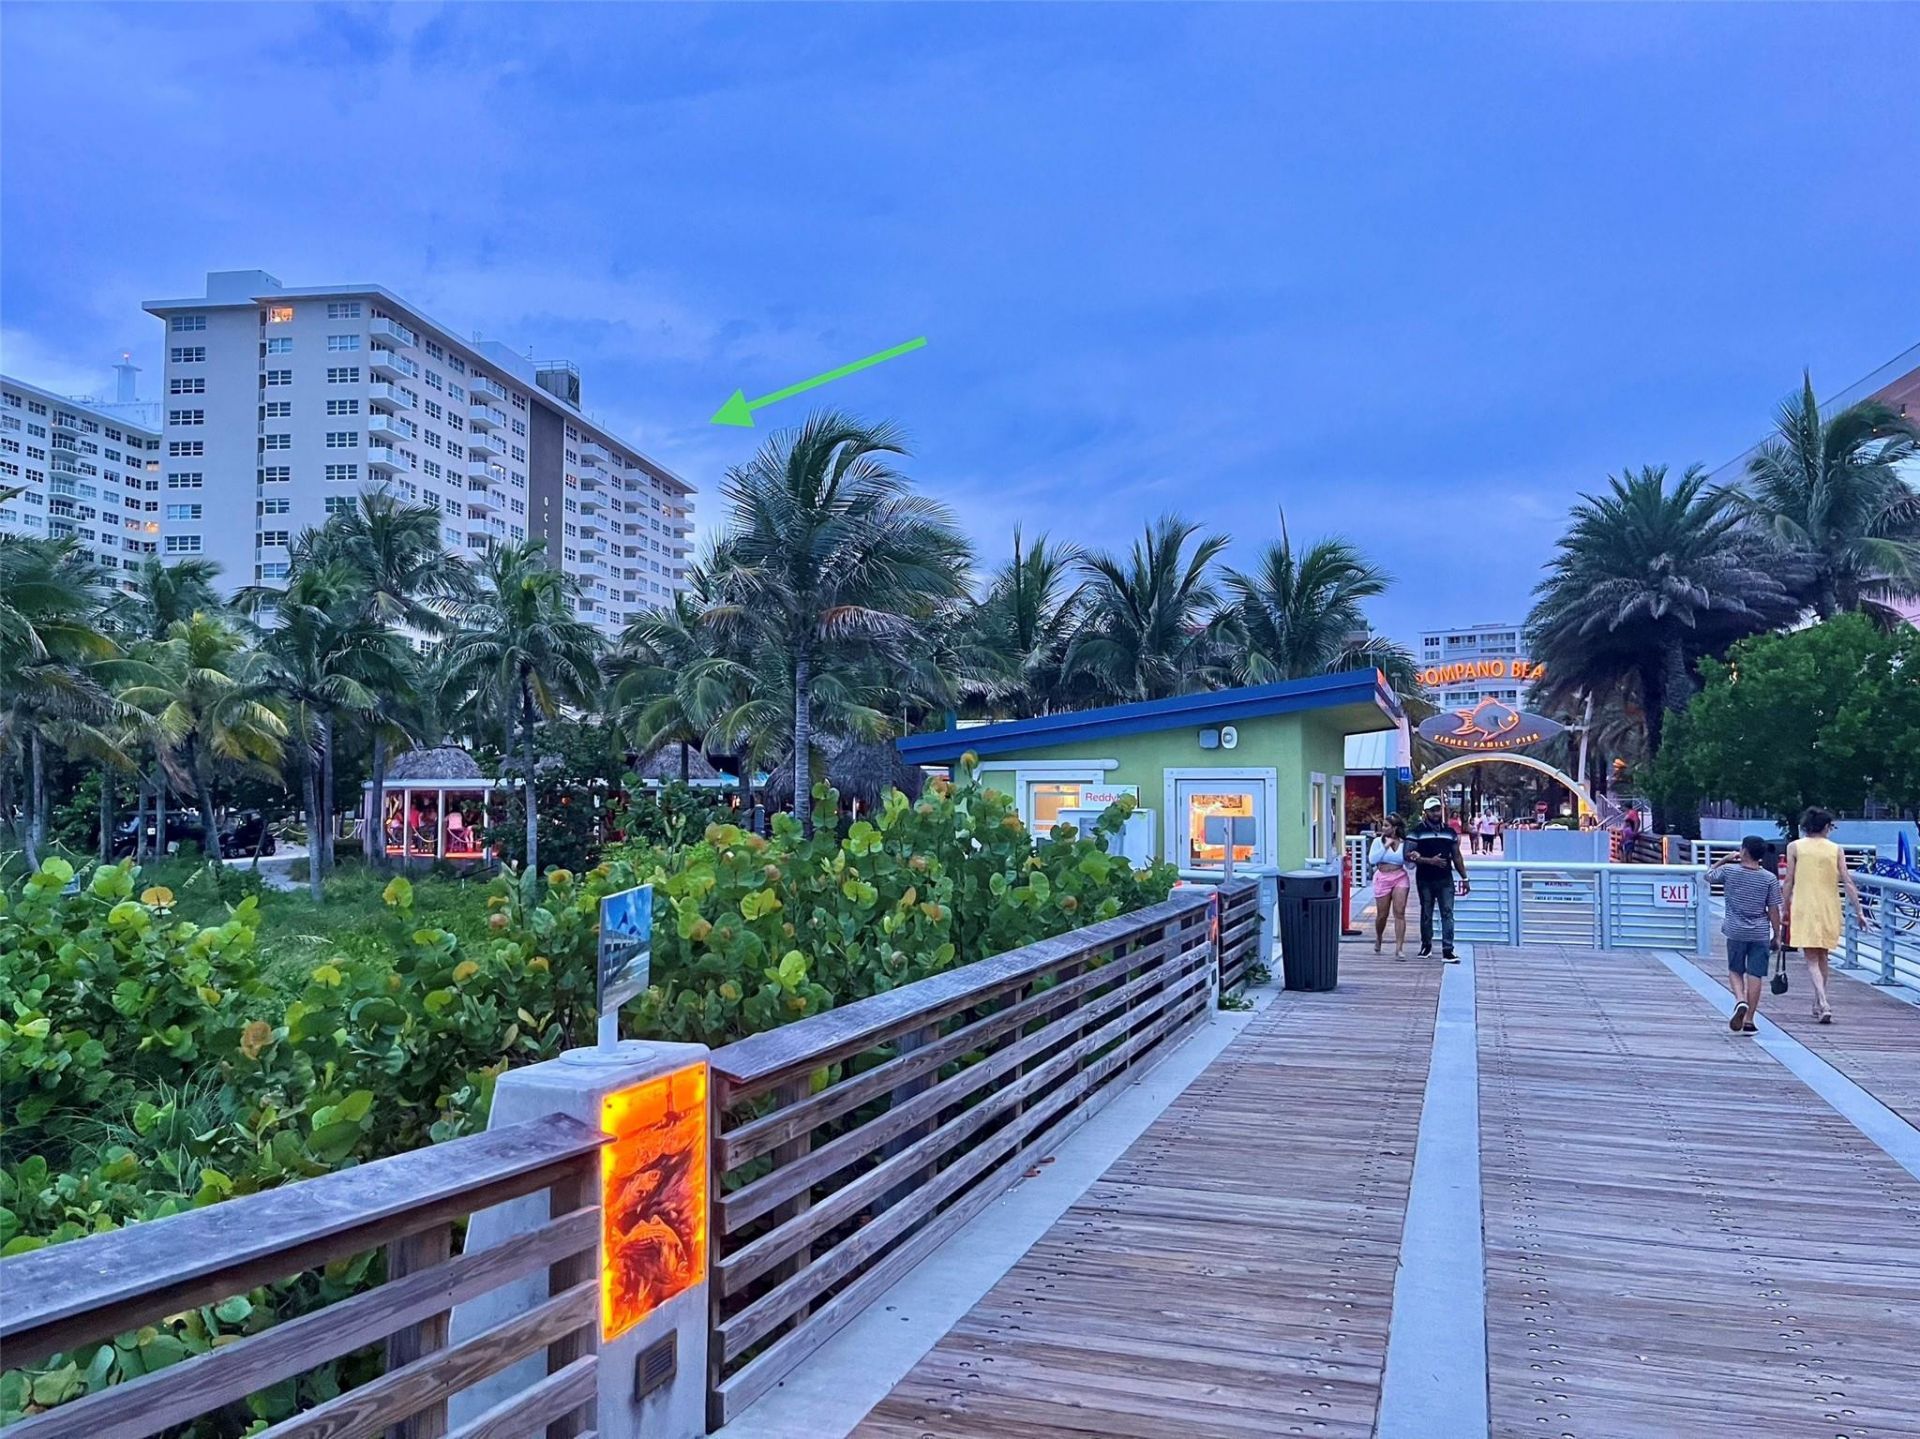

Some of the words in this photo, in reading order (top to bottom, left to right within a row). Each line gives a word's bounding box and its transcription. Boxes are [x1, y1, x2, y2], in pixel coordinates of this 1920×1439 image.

[1434, 734, 1469, 747] FISHER
[1473, 740, 1511, 748] FAMILY
[1515, 733, 1539, 745] PIER
[1661, 884, 1689, 899] EXIT
